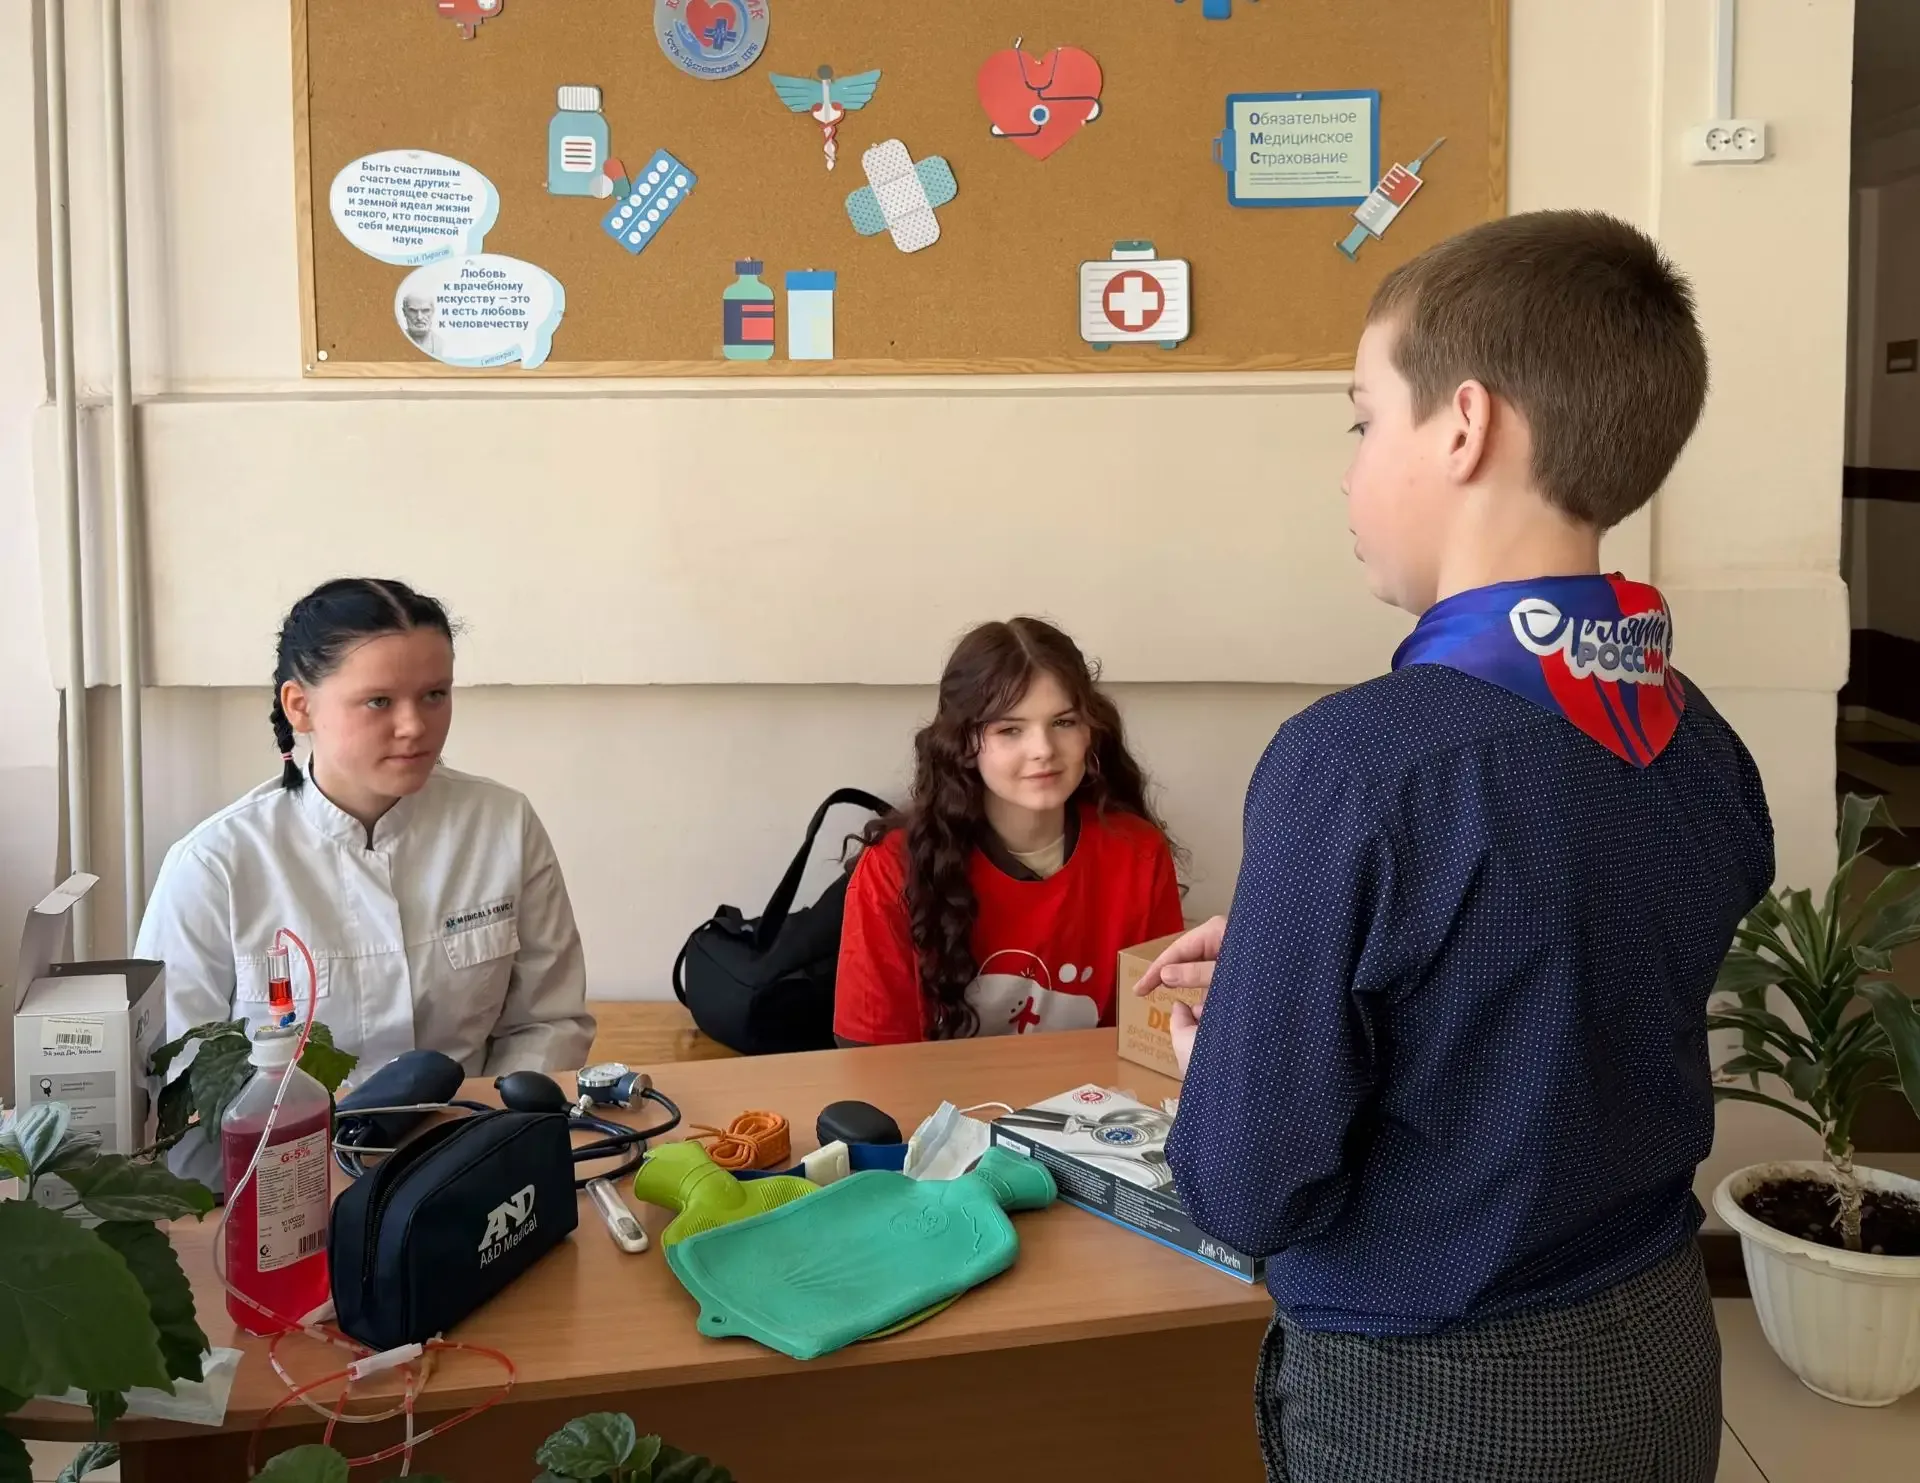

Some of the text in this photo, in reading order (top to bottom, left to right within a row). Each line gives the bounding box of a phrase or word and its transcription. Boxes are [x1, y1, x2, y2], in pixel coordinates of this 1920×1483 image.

[1249, 112, 1357, 126] Обязательное
[1250, 132, 1353, 146] Медицинское
[1250, 152, 1348, 167] Страхование
[361, 161, 461, 177] Быть счастливым
[359, 175, 411, 186] счастьем
[413, 179, 450, 188] других
[347, 185, 473, 202] вот настоящее счастье
[348, 197, 470, 213] и земной идеал жизни
[344, 209, 474, 225] всякого, кто посвящает
[358, 220, 459, 236] себя медицинской
[392, 236, 424, 246] науке
[460, 268, 507, 279] Любовь
[443, 281, 523, 293] к врачебному
[436, 295, 496, 304] искусству
[511, 295, 531, 303] это
[442, 306, 526, 316] и есть любовь
[438, 320, 529, 331] к человечеству
[1576, 641, 1664, 675] РОССИИ
[457, 910, 487, 924] MEDICAL
[480, 1211, 538, 1270] A&D Medical
[1197, 1239, 1217, 1260] Little
